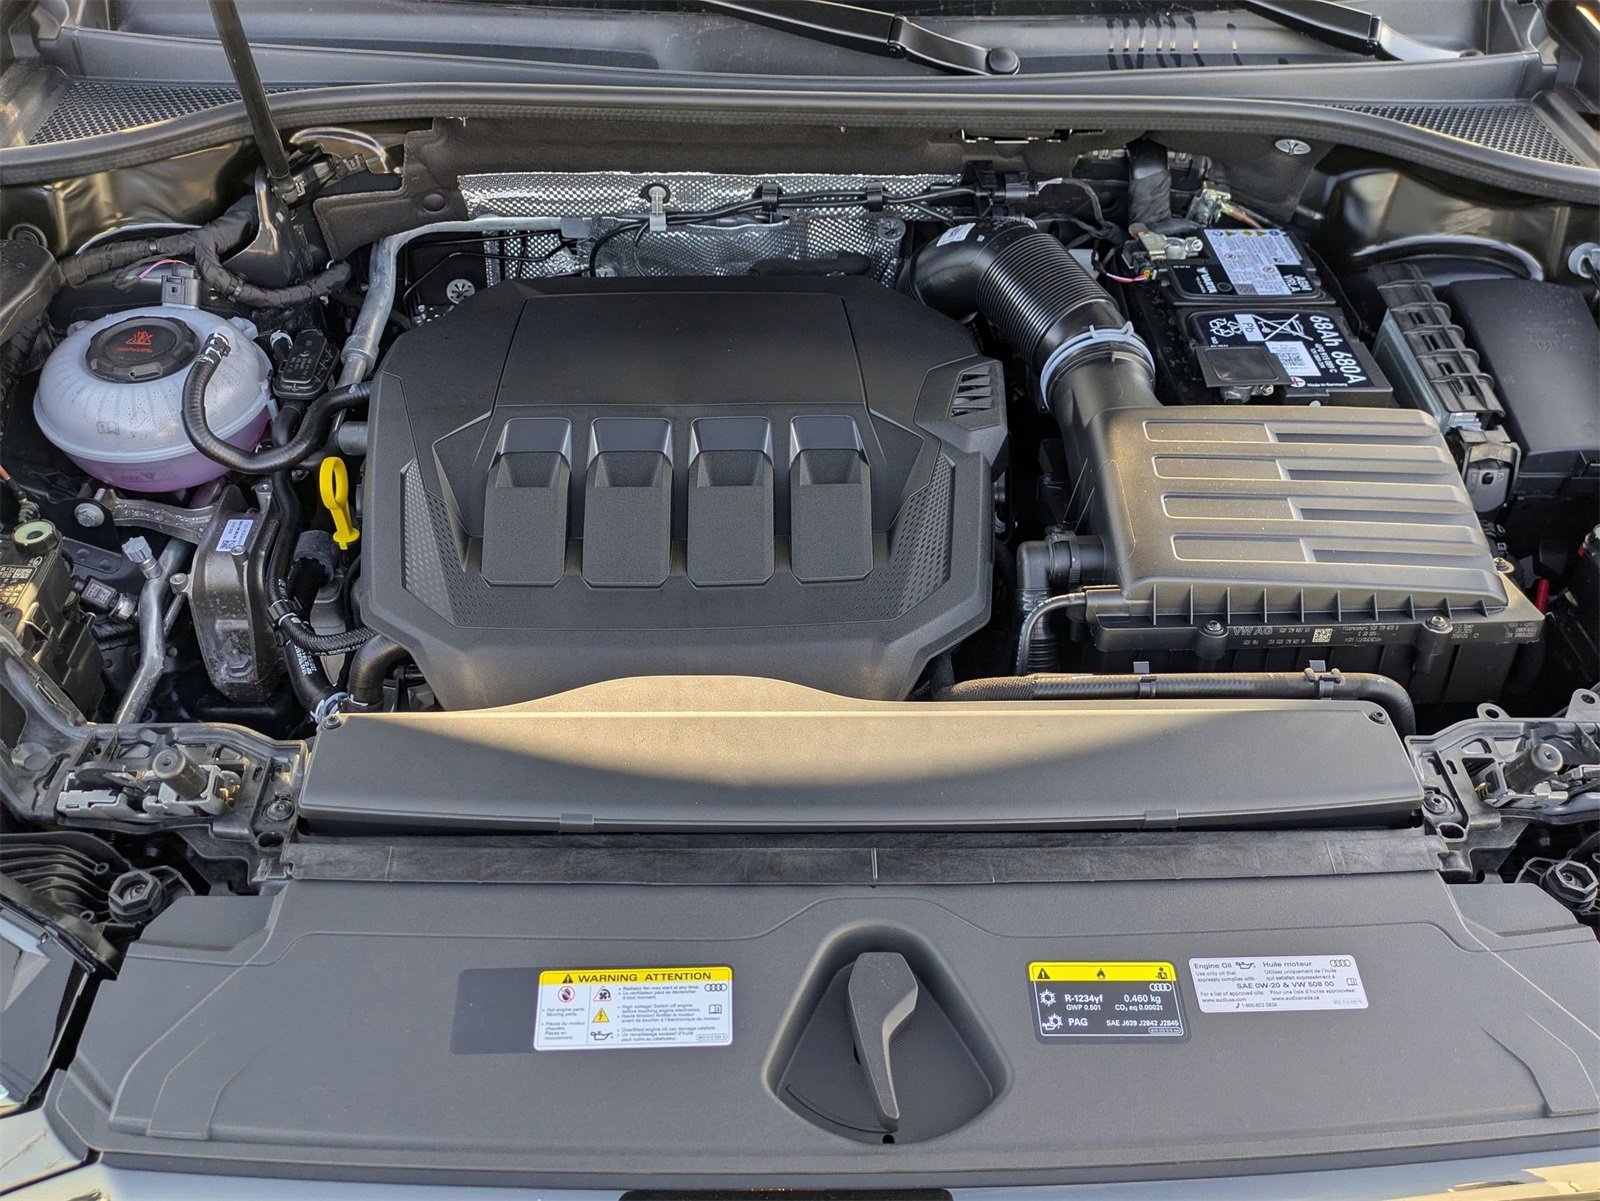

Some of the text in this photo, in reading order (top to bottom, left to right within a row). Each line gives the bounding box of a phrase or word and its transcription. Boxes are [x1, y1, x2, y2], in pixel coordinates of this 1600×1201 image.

[1283, 273, 1299, 293] VRLA
[1242, 322, 1255, 333] Pb
[1309, 315, 1367, 384] 68Ah 680A
[578, 972, 711, 982] WARNING ATTENTION
[1064, 994, 1162, 1004] R-1234yf 0.460 kg
[1068, 1018, 1089, 1026] PAG
[1160, 1019, 1180, 1027] J2845
